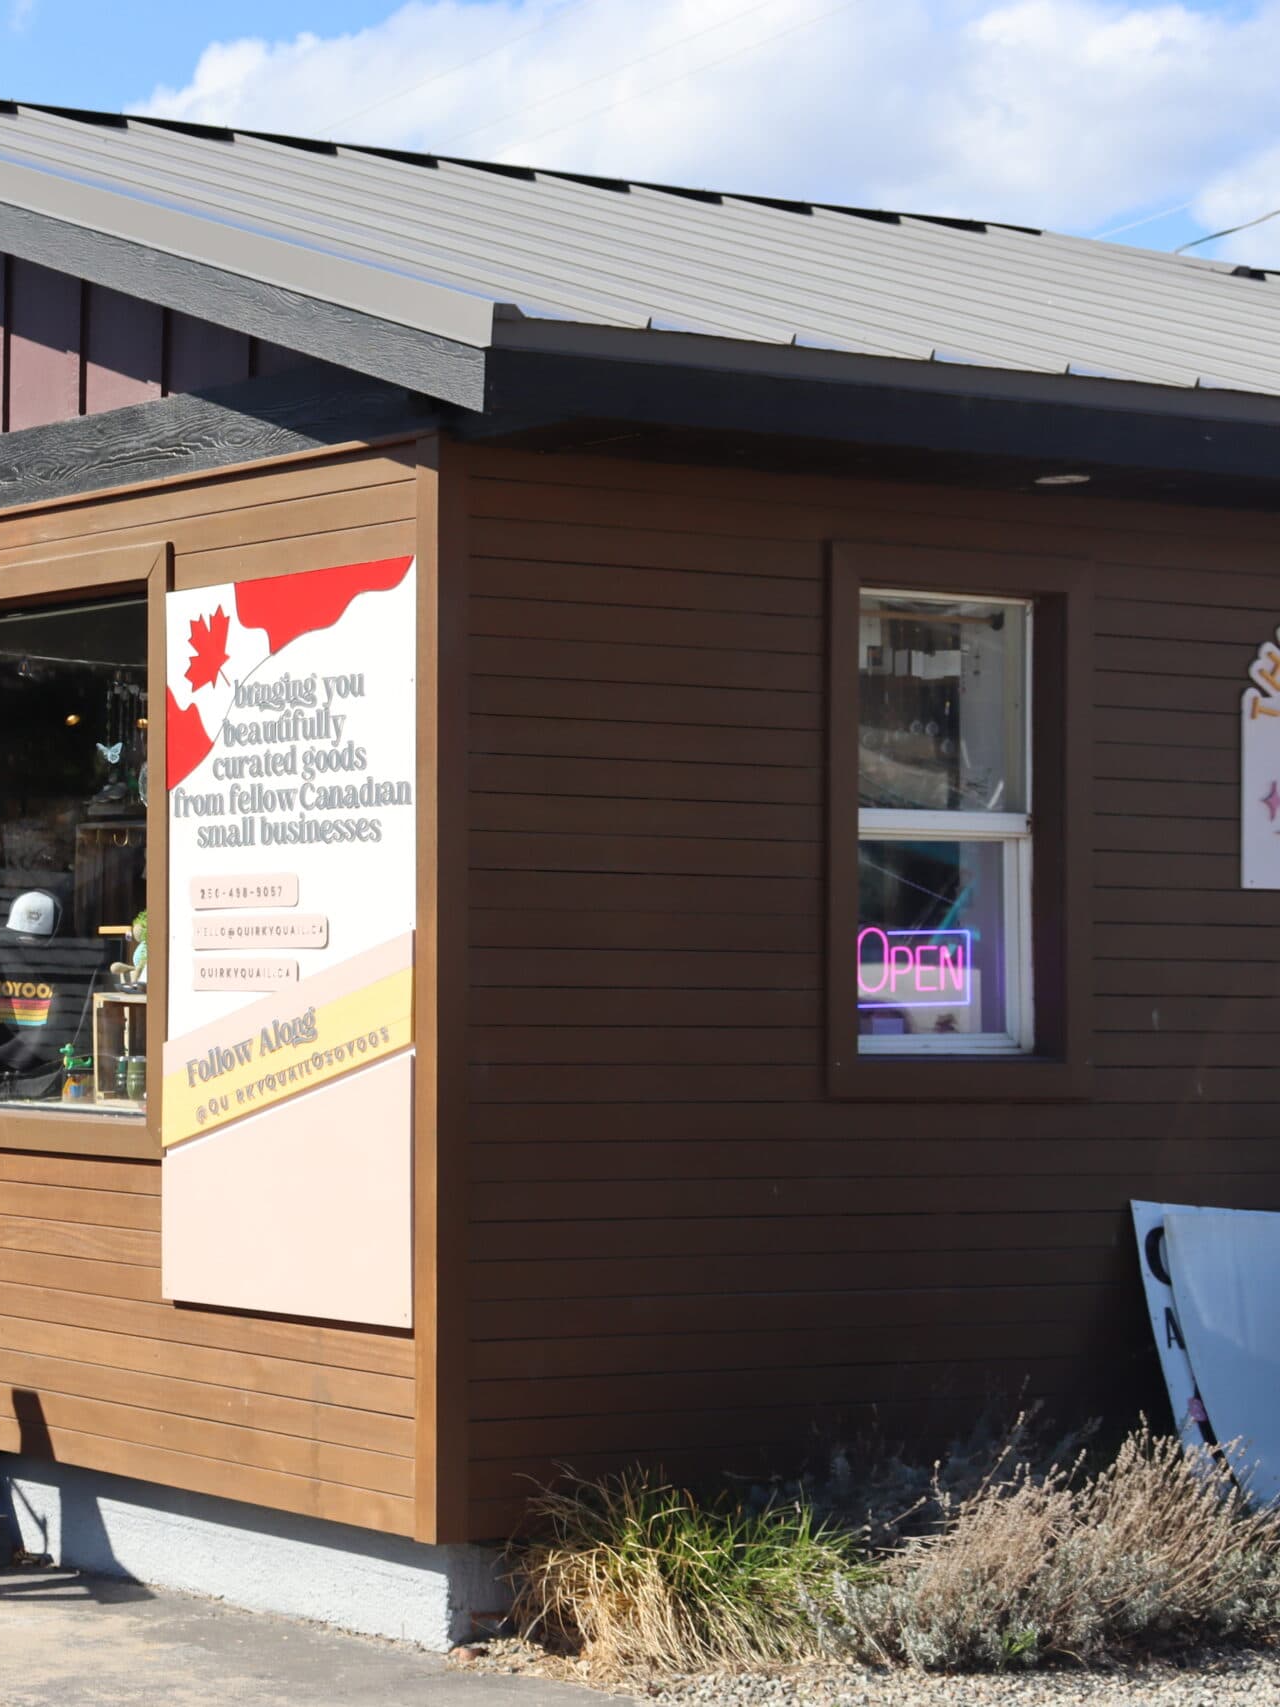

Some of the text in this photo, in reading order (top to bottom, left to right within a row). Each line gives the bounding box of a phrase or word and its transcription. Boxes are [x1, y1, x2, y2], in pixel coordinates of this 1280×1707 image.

[234, 672, 366, 712] bringing you
[222, 708, 347, 748] beautifully
[212, 740, 368, 782] curated goods
[173, 776, 413, 818] from fellow Canadian
[197, 812, 383, 849] small businesses
[857, 927, 963, 993] OPEN
[186, 1006, 319, 1088] Follow Along
[196, 1026, 391, 1125] @QURKYQUAILOSOYOOS
